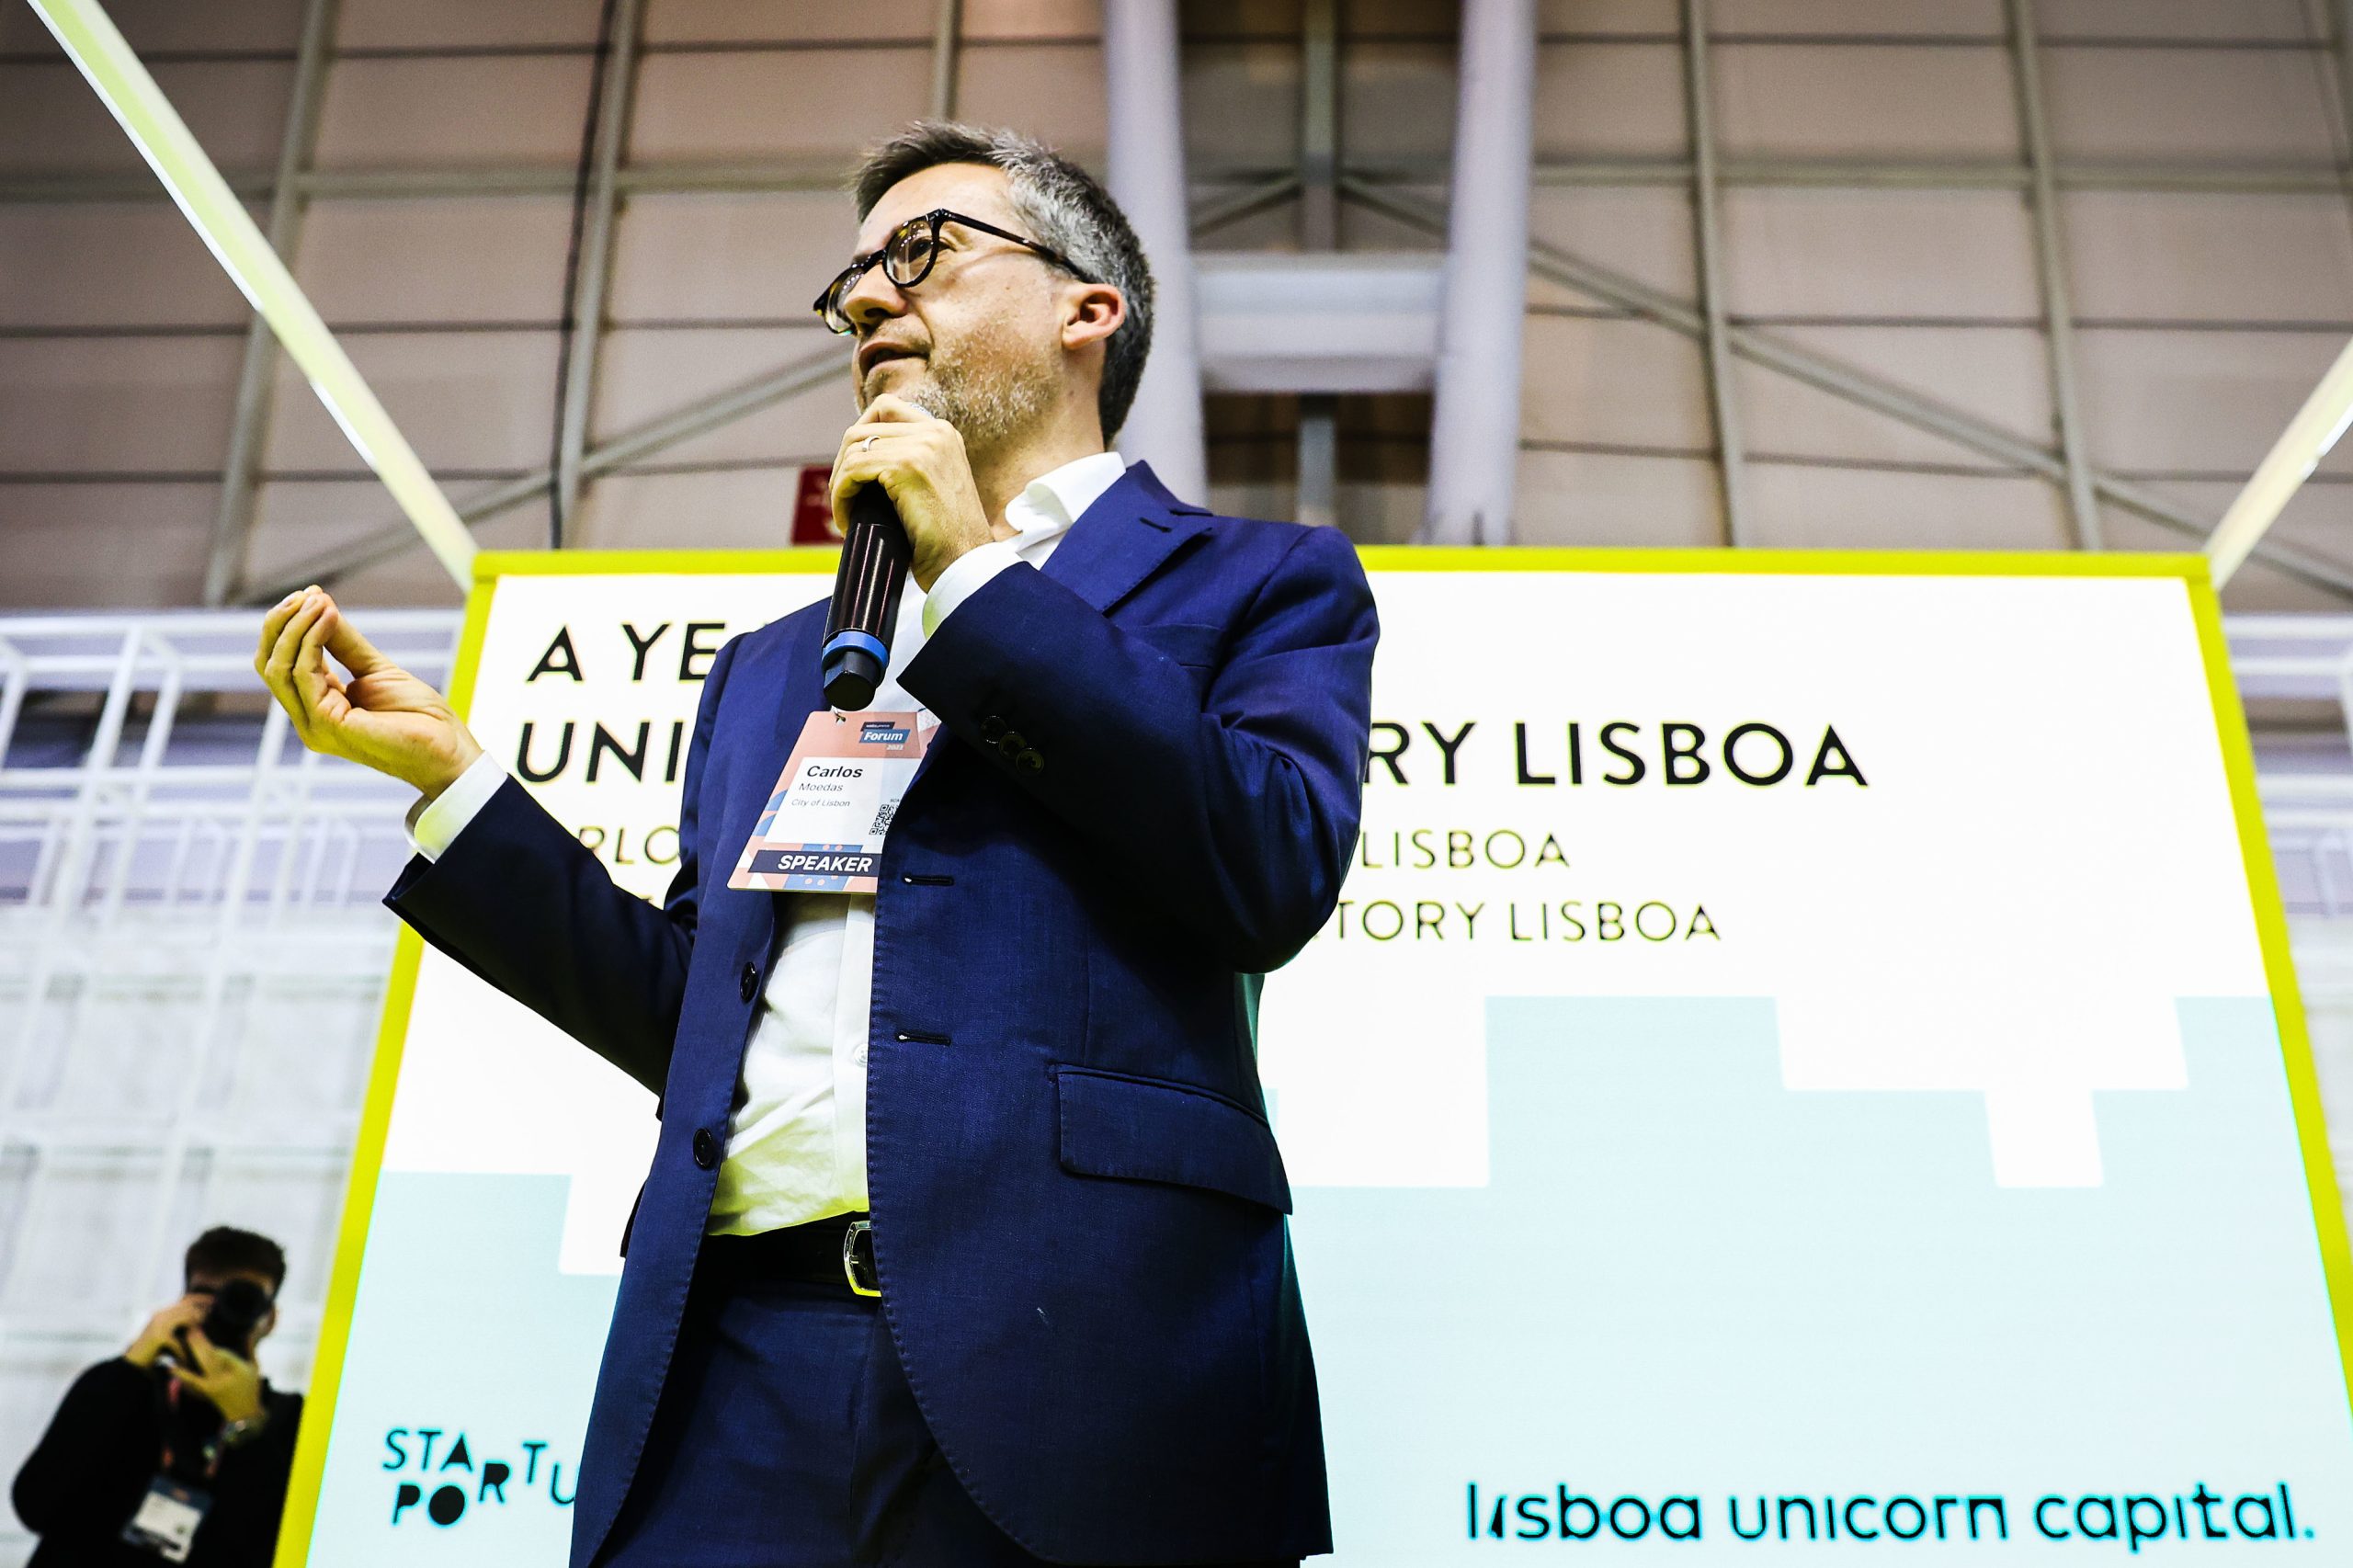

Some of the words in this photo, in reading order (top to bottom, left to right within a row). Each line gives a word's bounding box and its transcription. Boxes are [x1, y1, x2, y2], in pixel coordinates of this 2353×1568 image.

[527, 625, 584, 682] A
[621, 622, 726, 682] YE
[864, 731, 903, 741] Forum
[1515, 722, 1869, 788] LISBOA
[807, 766, 863, 778] Carlos
[799, 783, 844, 791] Moedas
[791, 799, 809, 807] City
[822, 799, 850, 807] Lisbon
[1362, 829, 1570, 869] LISBOA
[778, 855, 873, 872] SPEAKER
[1337, 900, 1485, 942] TORY
[1510, 900, 1721, 942] LISBOA
[1728, 1494, 2008, 1541] unicorn
[2033, 1482, 2315, 1554] capital.
